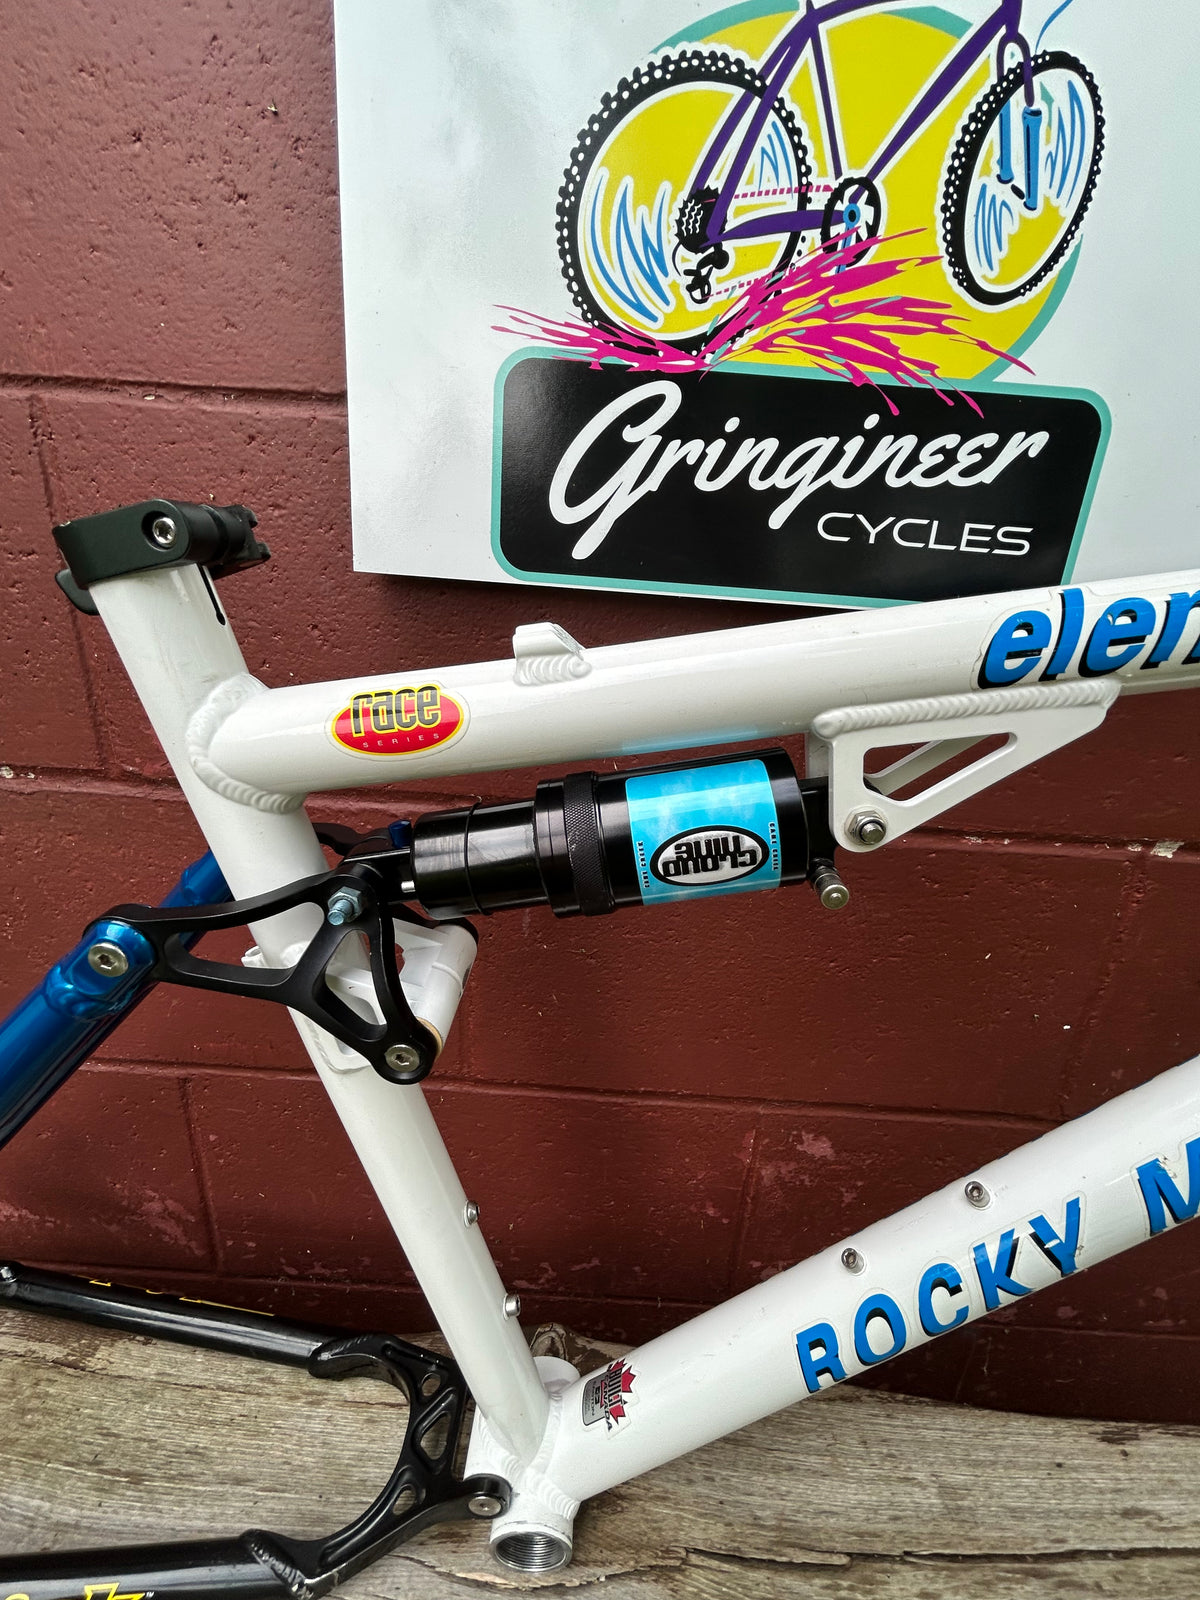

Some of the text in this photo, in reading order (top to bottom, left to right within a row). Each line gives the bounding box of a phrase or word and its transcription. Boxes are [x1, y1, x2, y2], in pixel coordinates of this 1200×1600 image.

[548, 380, 1049, 560] Gringineer
[817, 512, 1034, 556] CYCLES
[351, 685, 441, 736] race
[362, 732, 440, 748] SERIES
[661, 848, 758, 877] CLOUD
[795, 1196, 1081, 1394] ROCKY
[603, 1374, 613, 1432] CANADA
[608, 1367, 623, 1408] BUILT
